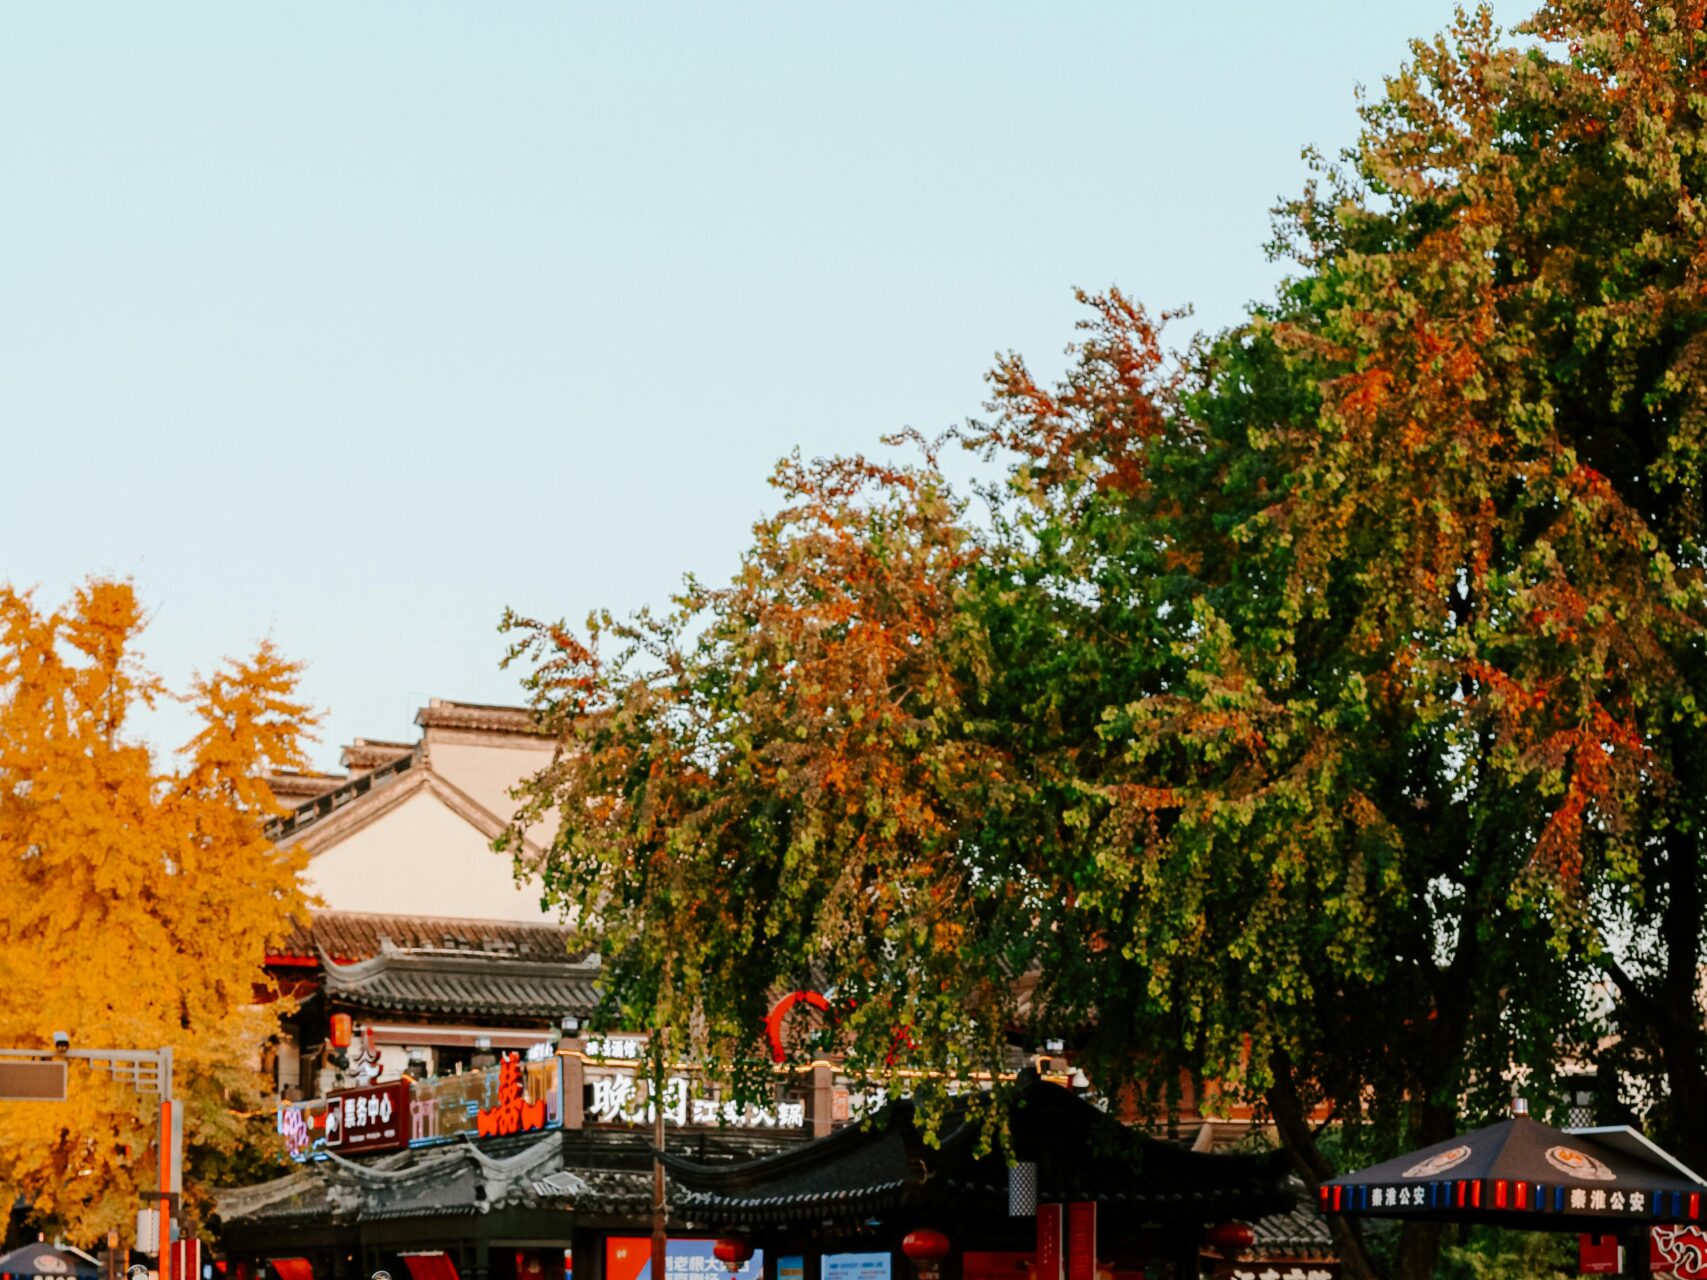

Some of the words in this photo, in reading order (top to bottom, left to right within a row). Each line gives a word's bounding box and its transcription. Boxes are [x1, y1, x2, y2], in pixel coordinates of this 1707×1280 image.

[344, 1092, 393, 1129] 票务中心
[1371, 1186, 1425, 1207] 秦淮公安
[1571, 1187, 1645, 1212] 秦淮公安
[665, 1255, 749, 1273] 老根大
